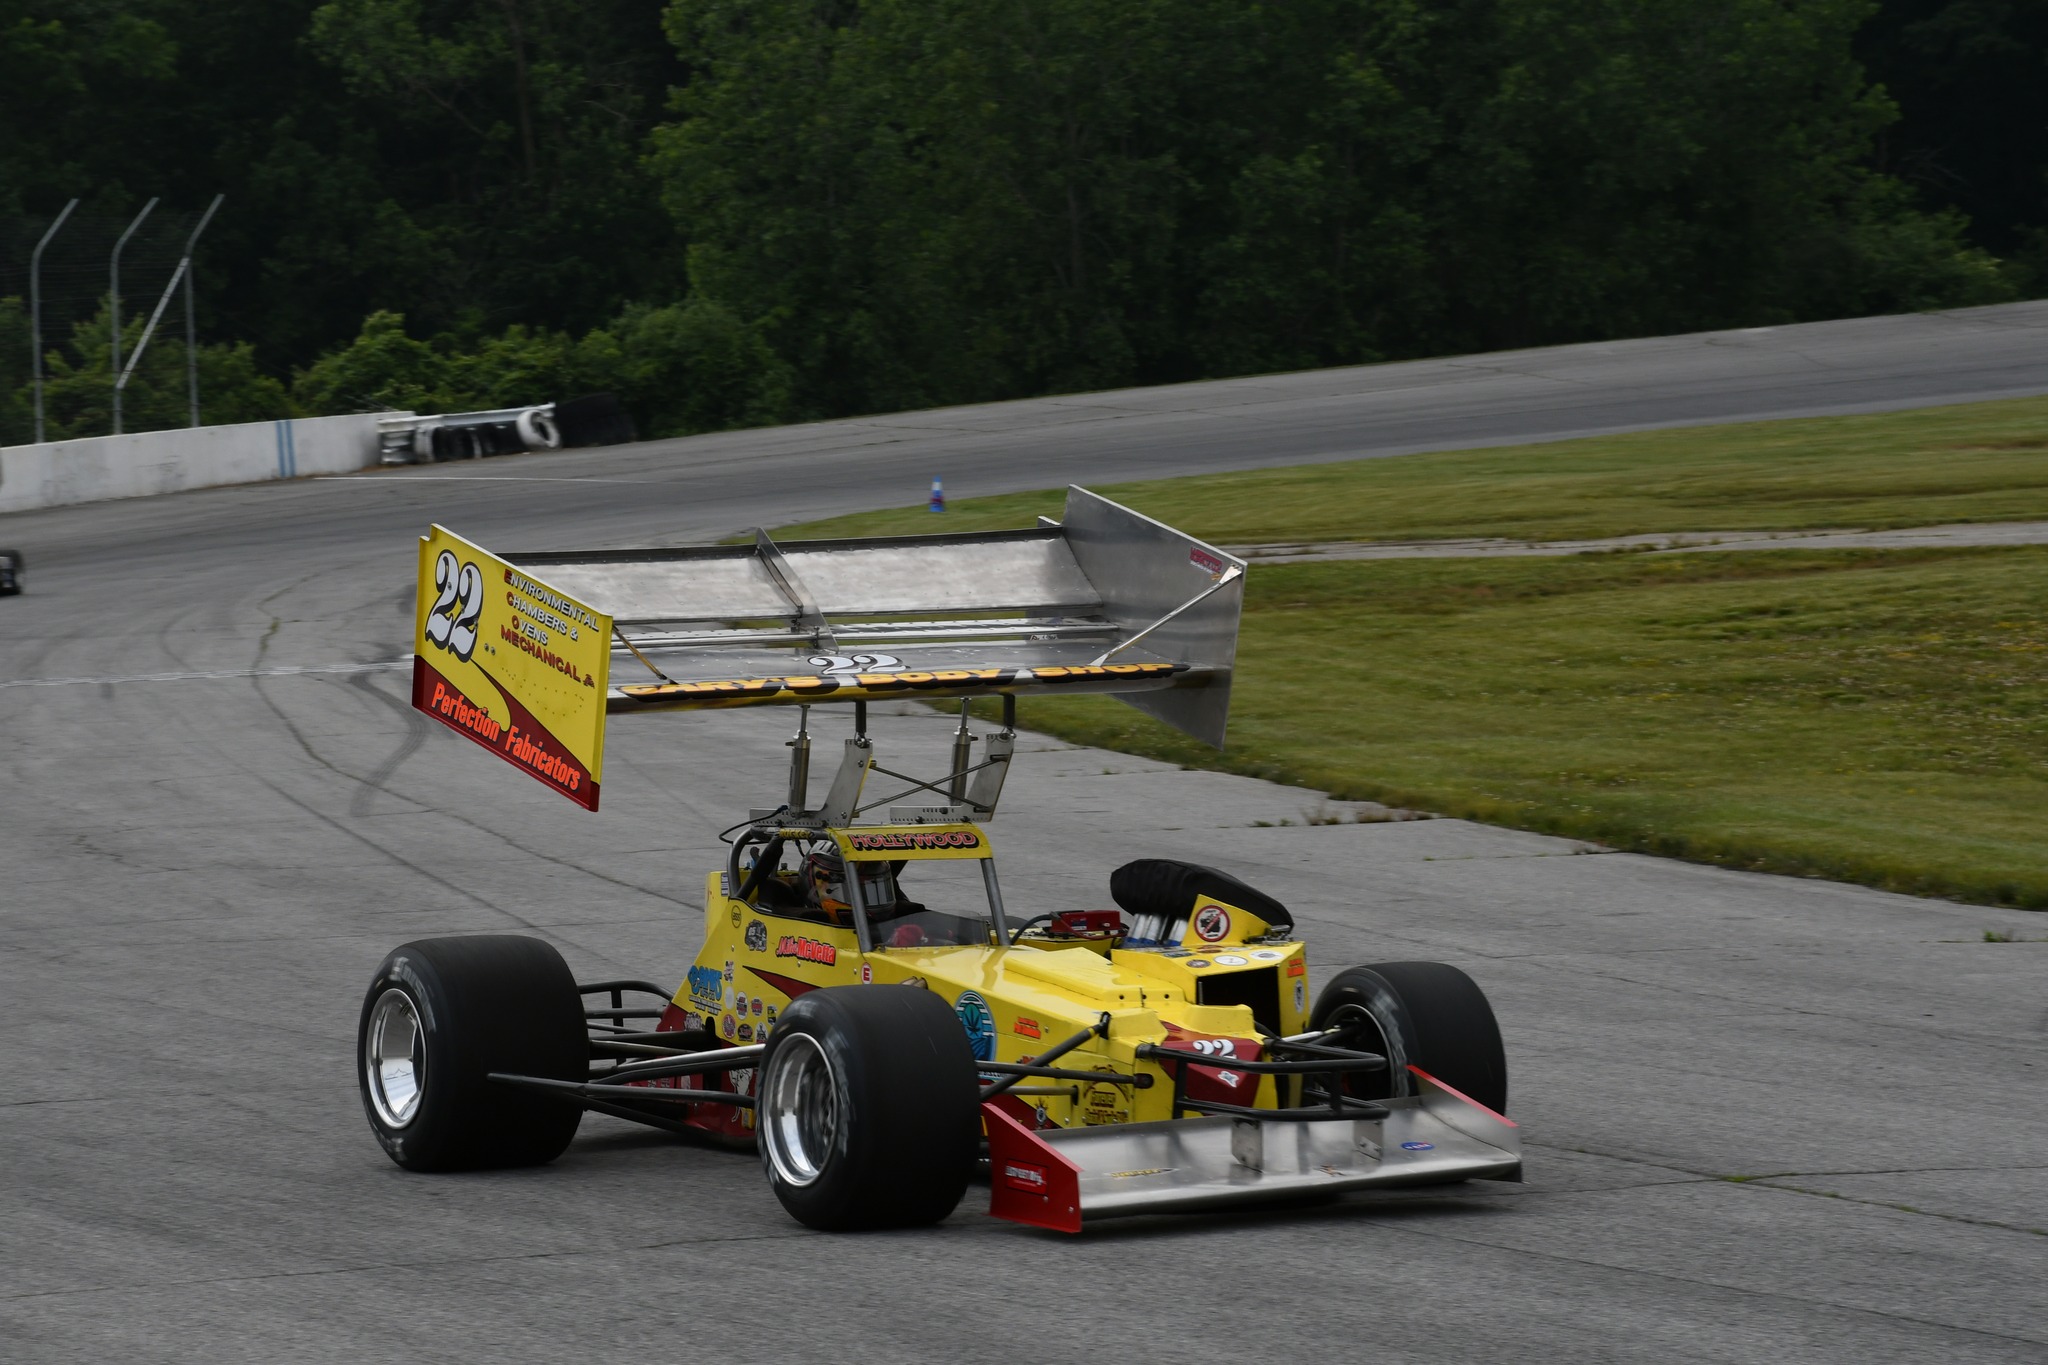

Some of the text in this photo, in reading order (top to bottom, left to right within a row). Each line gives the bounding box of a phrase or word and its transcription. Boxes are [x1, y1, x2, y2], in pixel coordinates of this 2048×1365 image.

[425, 549, 484, 663] 22
[503, 569, 600, 632] ENVIRONMENTAL
[506, 591, 579, 641] CHAMBERS &
[500, 625, 582, 682] MECHANICAL
[511, 615, 548, 646] OVENS
[617, 662, 1182, 698] GARY'S BODY SHOP
[807, 653, 911, 675] 22
[431, 681, 501, 742] Perfection
[505, 726, 582, 792] Fabricators
[848, 831, 979, 851] HOLLYWOOD
[863, 967, 870, 981] E
